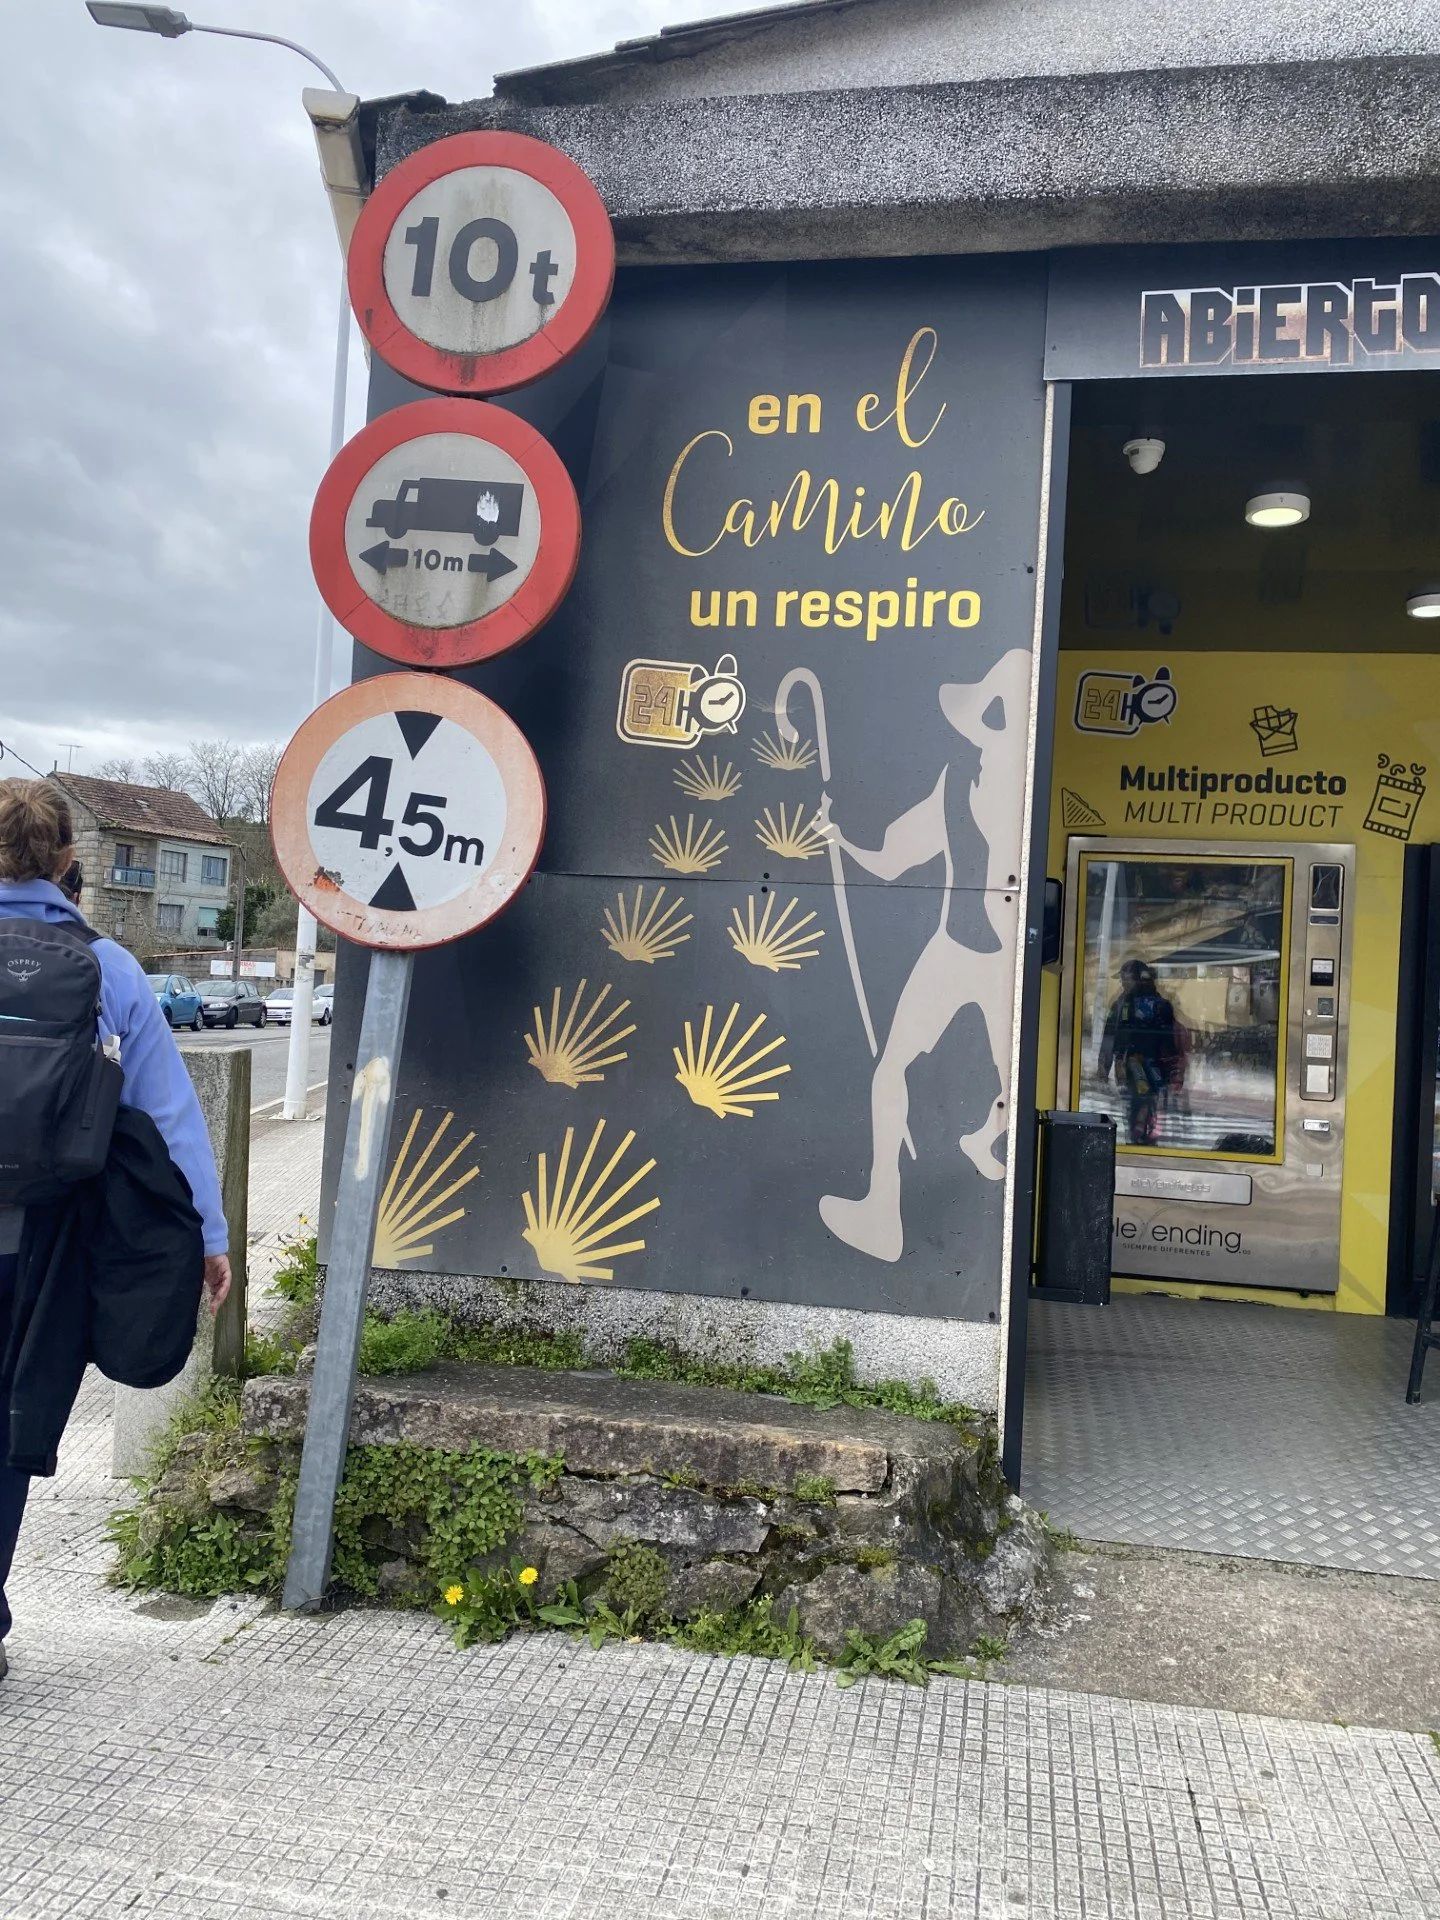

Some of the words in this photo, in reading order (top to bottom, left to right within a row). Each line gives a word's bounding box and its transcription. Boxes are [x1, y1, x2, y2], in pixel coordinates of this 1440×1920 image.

[748, 393, 822, 434] en
[856, 326, 946, 448] el
[690, 589, 757, 627] un
[775, 577, 981, 642] respiro
[1120, 765, 1347, 800] Multiproducto
[1124, 801, 1202, 824] MULTI
[1211, 803, 1344, 828] PRODUCT
[7, 959, 42, 967] OSPREY
[1122, 1243, 1158, 1252] SIEMPRE
[1160, 1245, 1211, 1257] DIFERENTES
